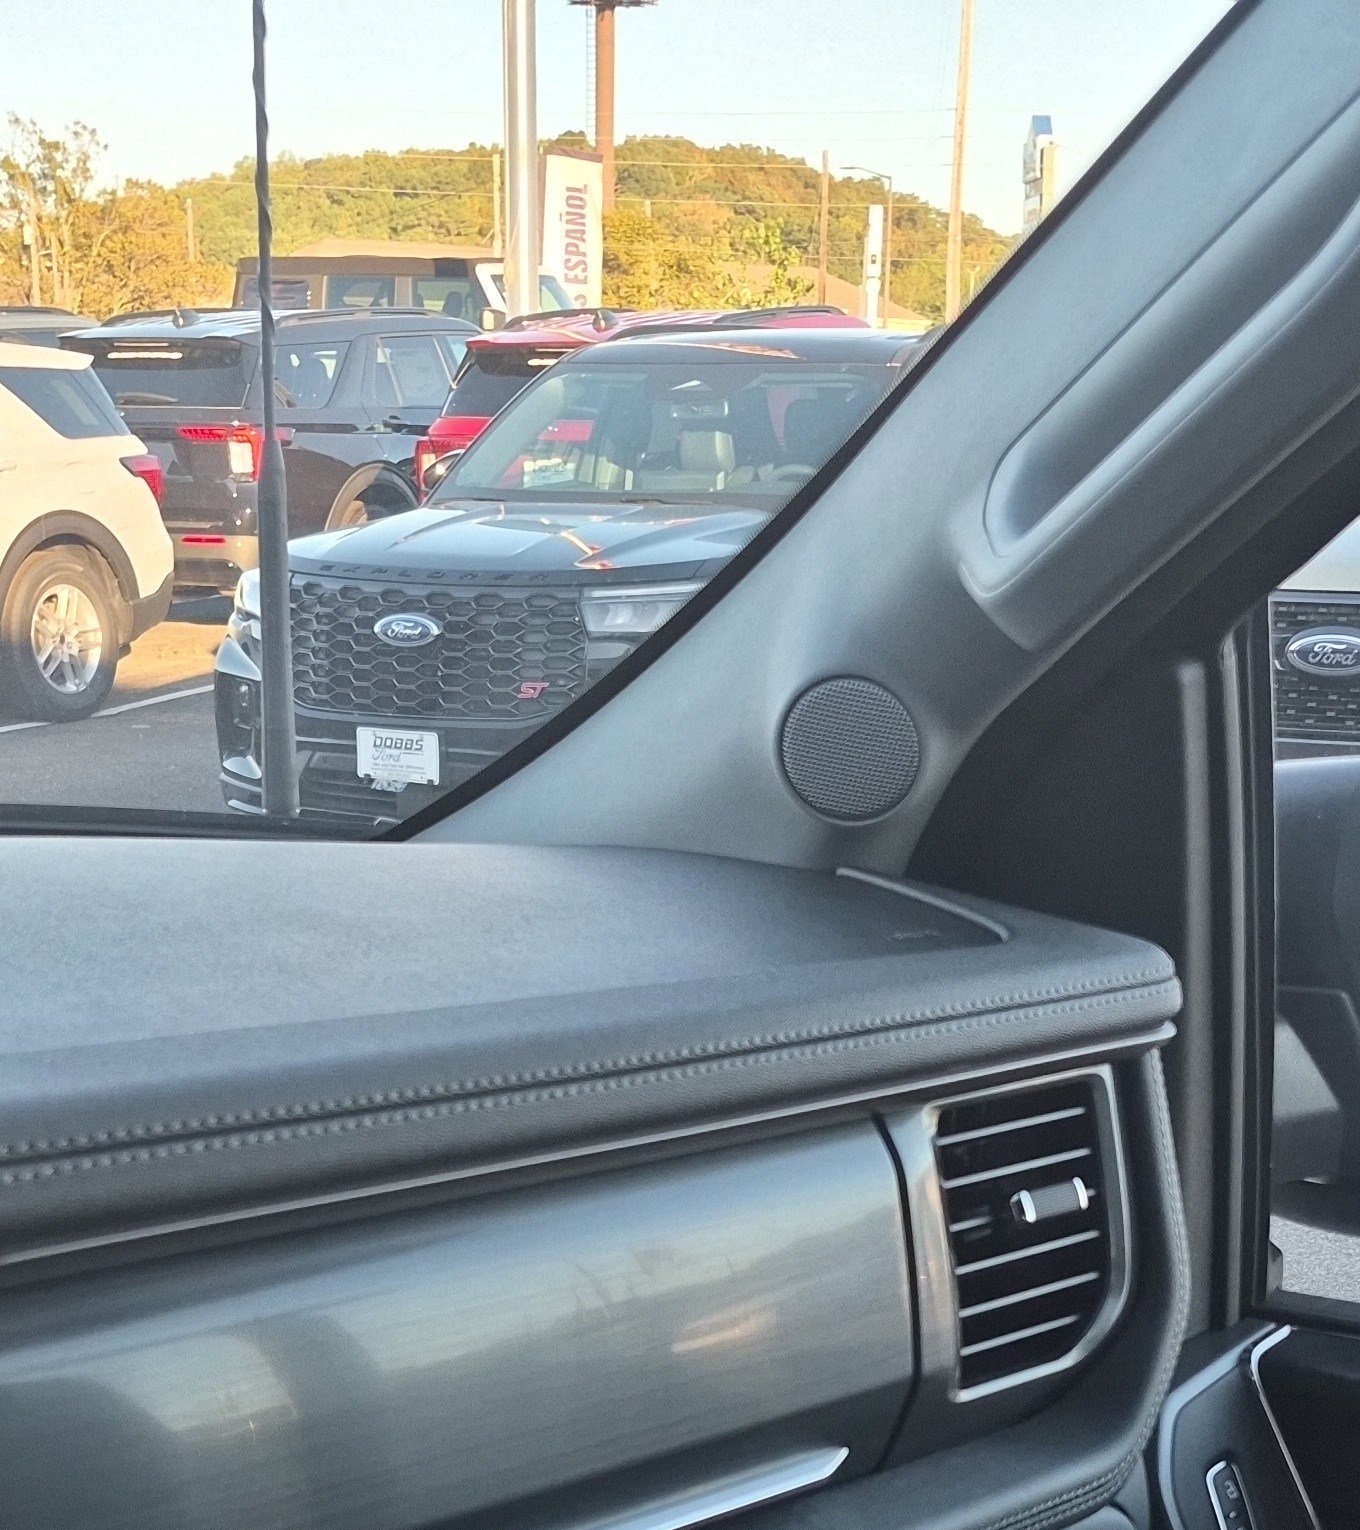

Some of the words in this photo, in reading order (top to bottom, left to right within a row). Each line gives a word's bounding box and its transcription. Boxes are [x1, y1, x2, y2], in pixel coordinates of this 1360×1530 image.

[560, 184, 588, 285] ESPAÑOL
[387, 620, 423, 640] Ford
[1308, 642, 1359, 666] Ford
[517, 682, 550, 700] ST
[373, 736, 424, 751] DOBBS
[371, 748, 402, 762] Ford
